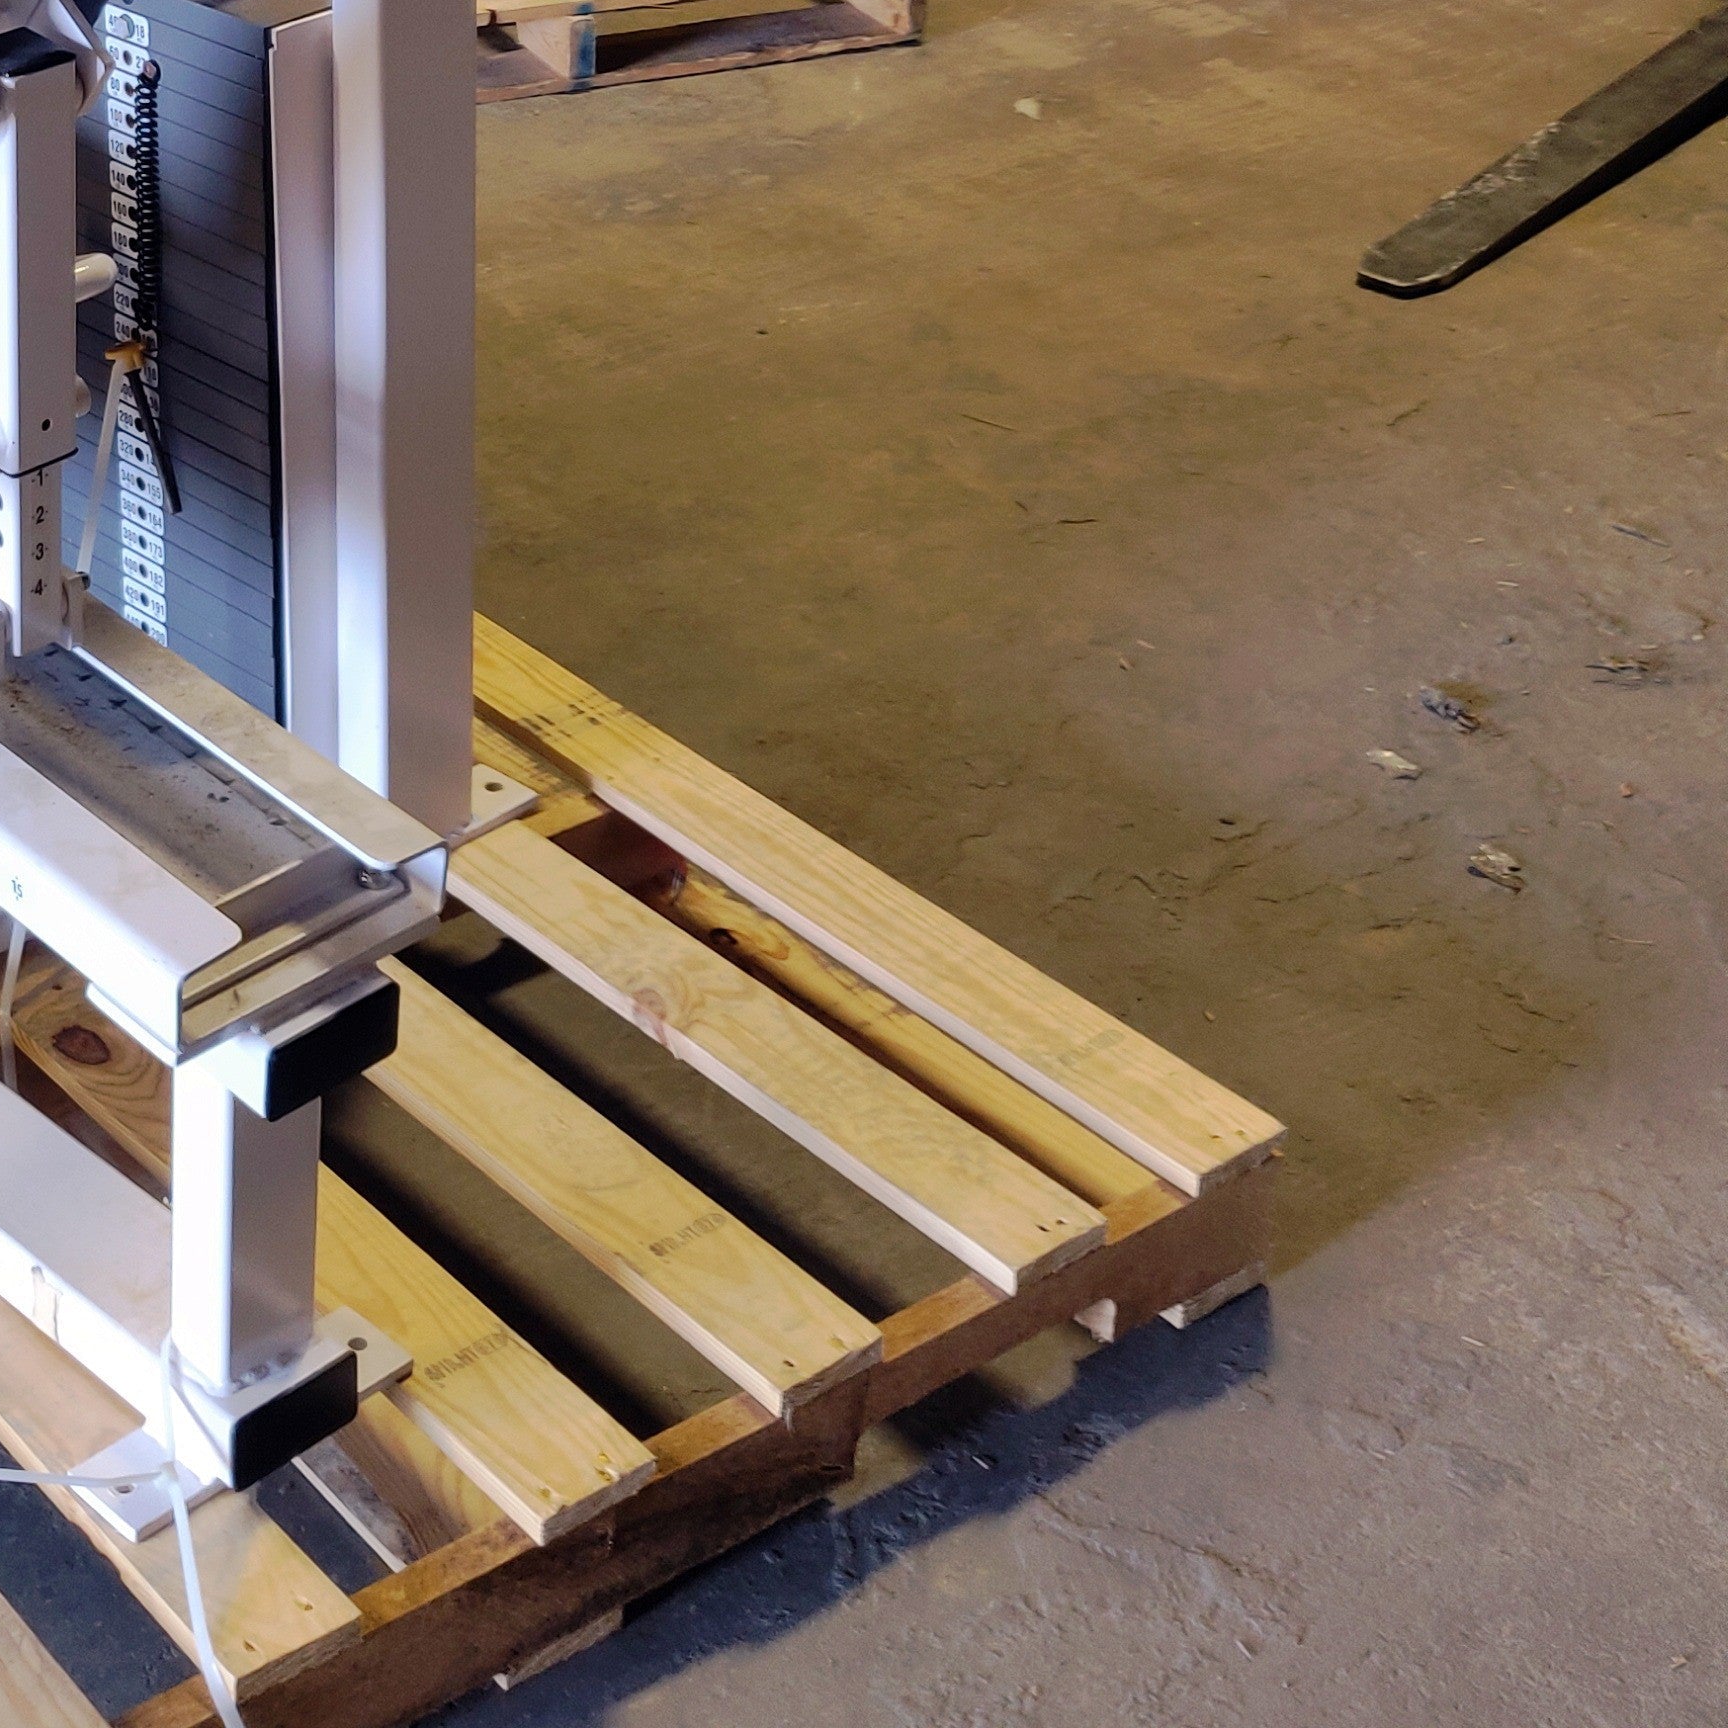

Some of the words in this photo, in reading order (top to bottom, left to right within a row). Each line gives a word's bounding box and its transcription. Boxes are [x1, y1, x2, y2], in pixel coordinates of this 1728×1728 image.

[111, 139, 125, 155] 120
[112, 169, 126, 186] 140
[116, 290, 130, 308] 220
[149, 541, 163, 558] 173
[150, 570, 164, 588] 182
[151, 599, 165, 616] 191
[11, 879, 23, 898] 15
